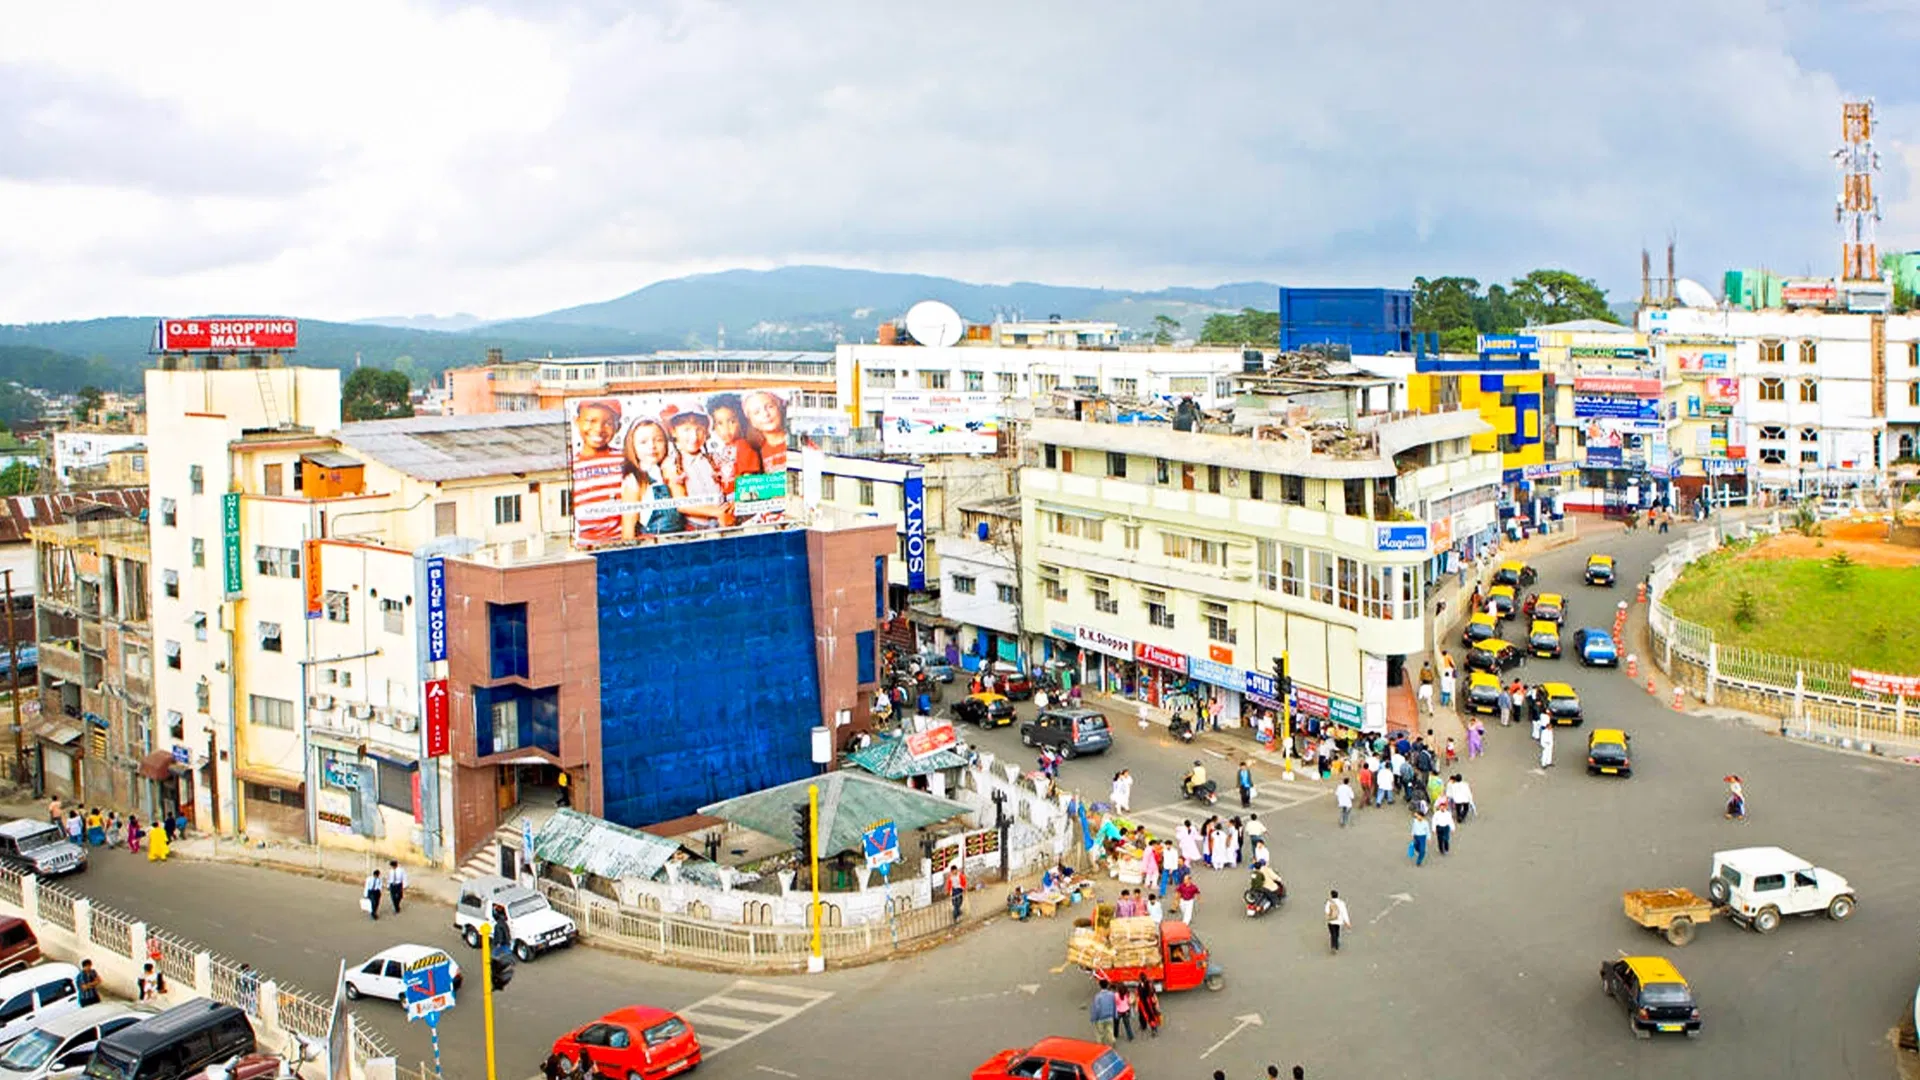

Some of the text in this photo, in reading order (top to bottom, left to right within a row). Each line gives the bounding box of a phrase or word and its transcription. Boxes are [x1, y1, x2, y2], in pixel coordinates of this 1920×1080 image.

[169, 322, 294, 335] O.B. SHOPPING
[210, 335, 256, 346] MALL
[907, 496, 924, 573] SONY
[430, 569, 444, 659] BLUE MOUNT
